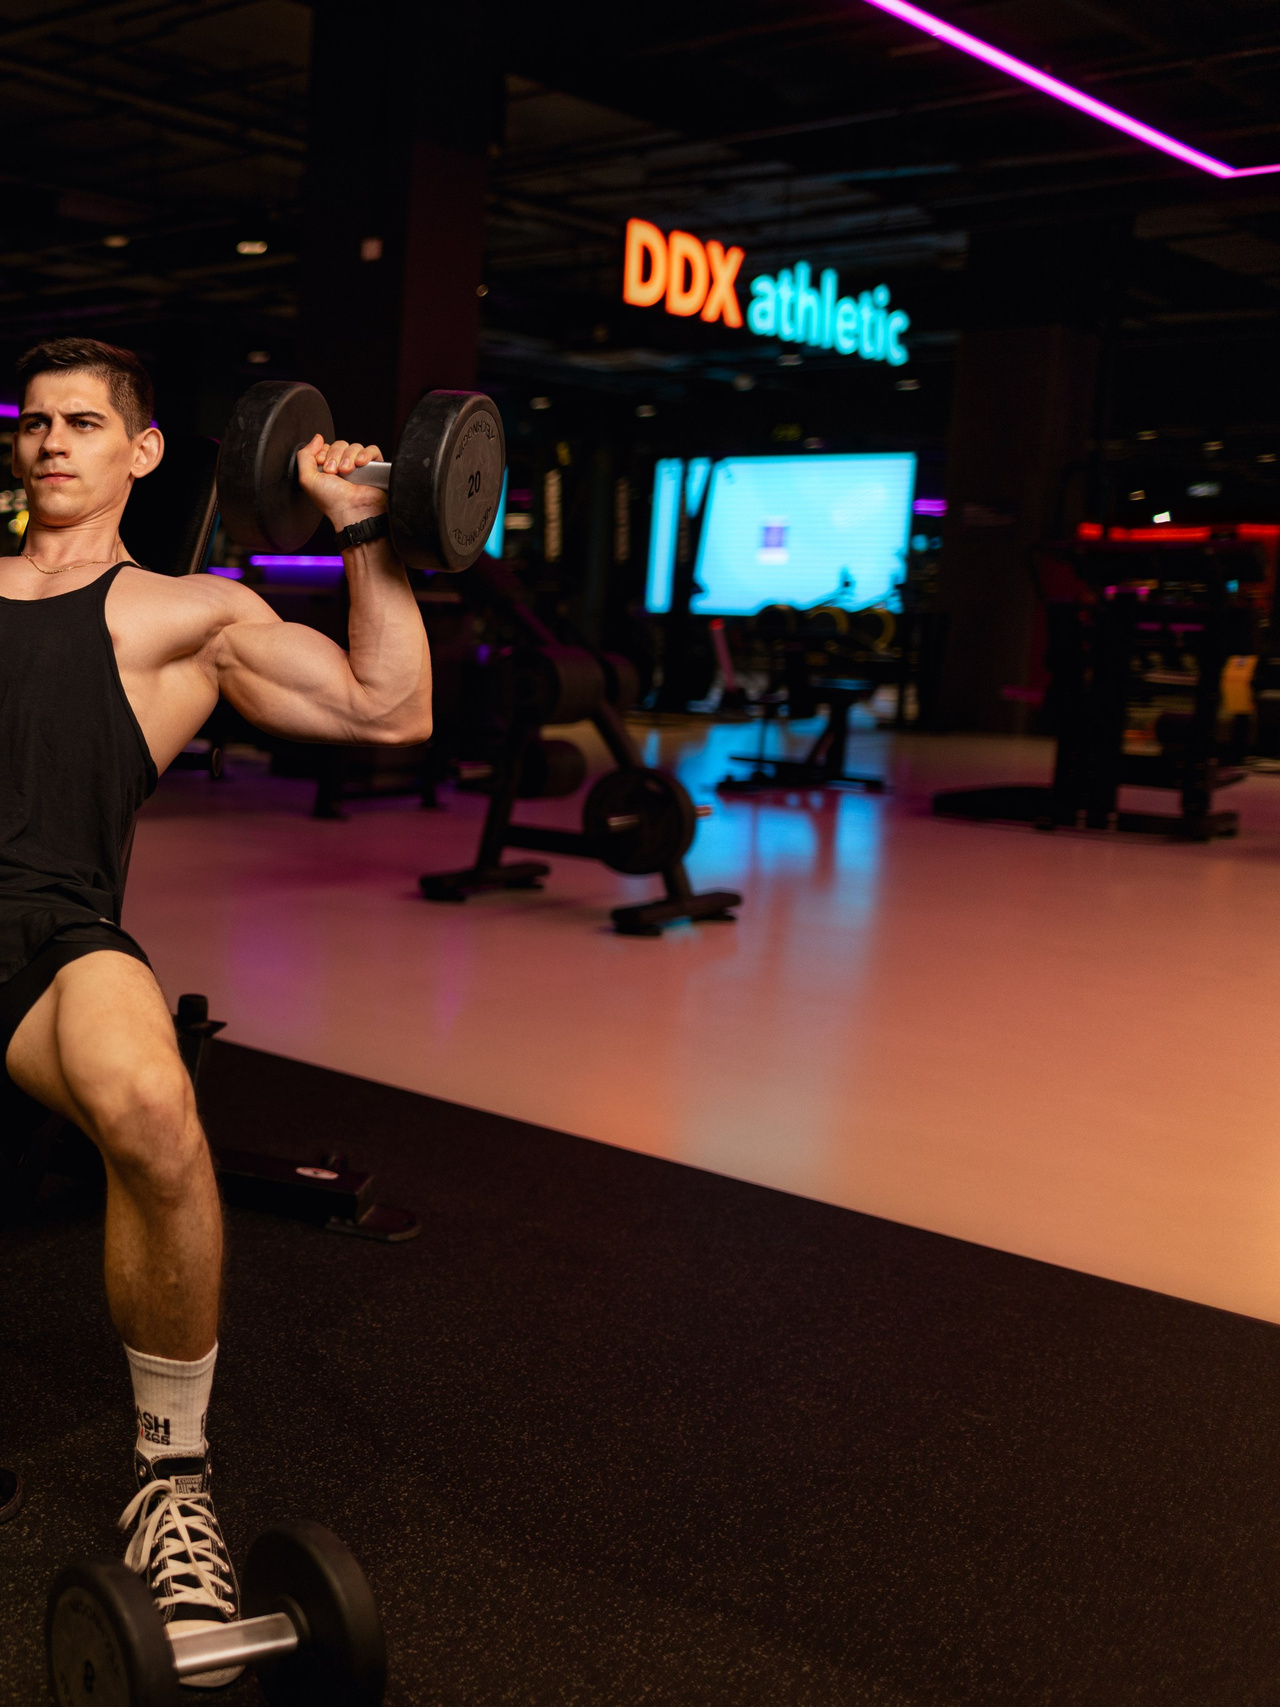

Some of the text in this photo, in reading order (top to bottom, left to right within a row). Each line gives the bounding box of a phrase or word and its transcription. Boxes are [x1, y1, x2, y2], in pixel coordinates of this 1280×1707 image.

[623, 217, 910, 367] DDX athletic
[468, 470, 481, 498] 20
